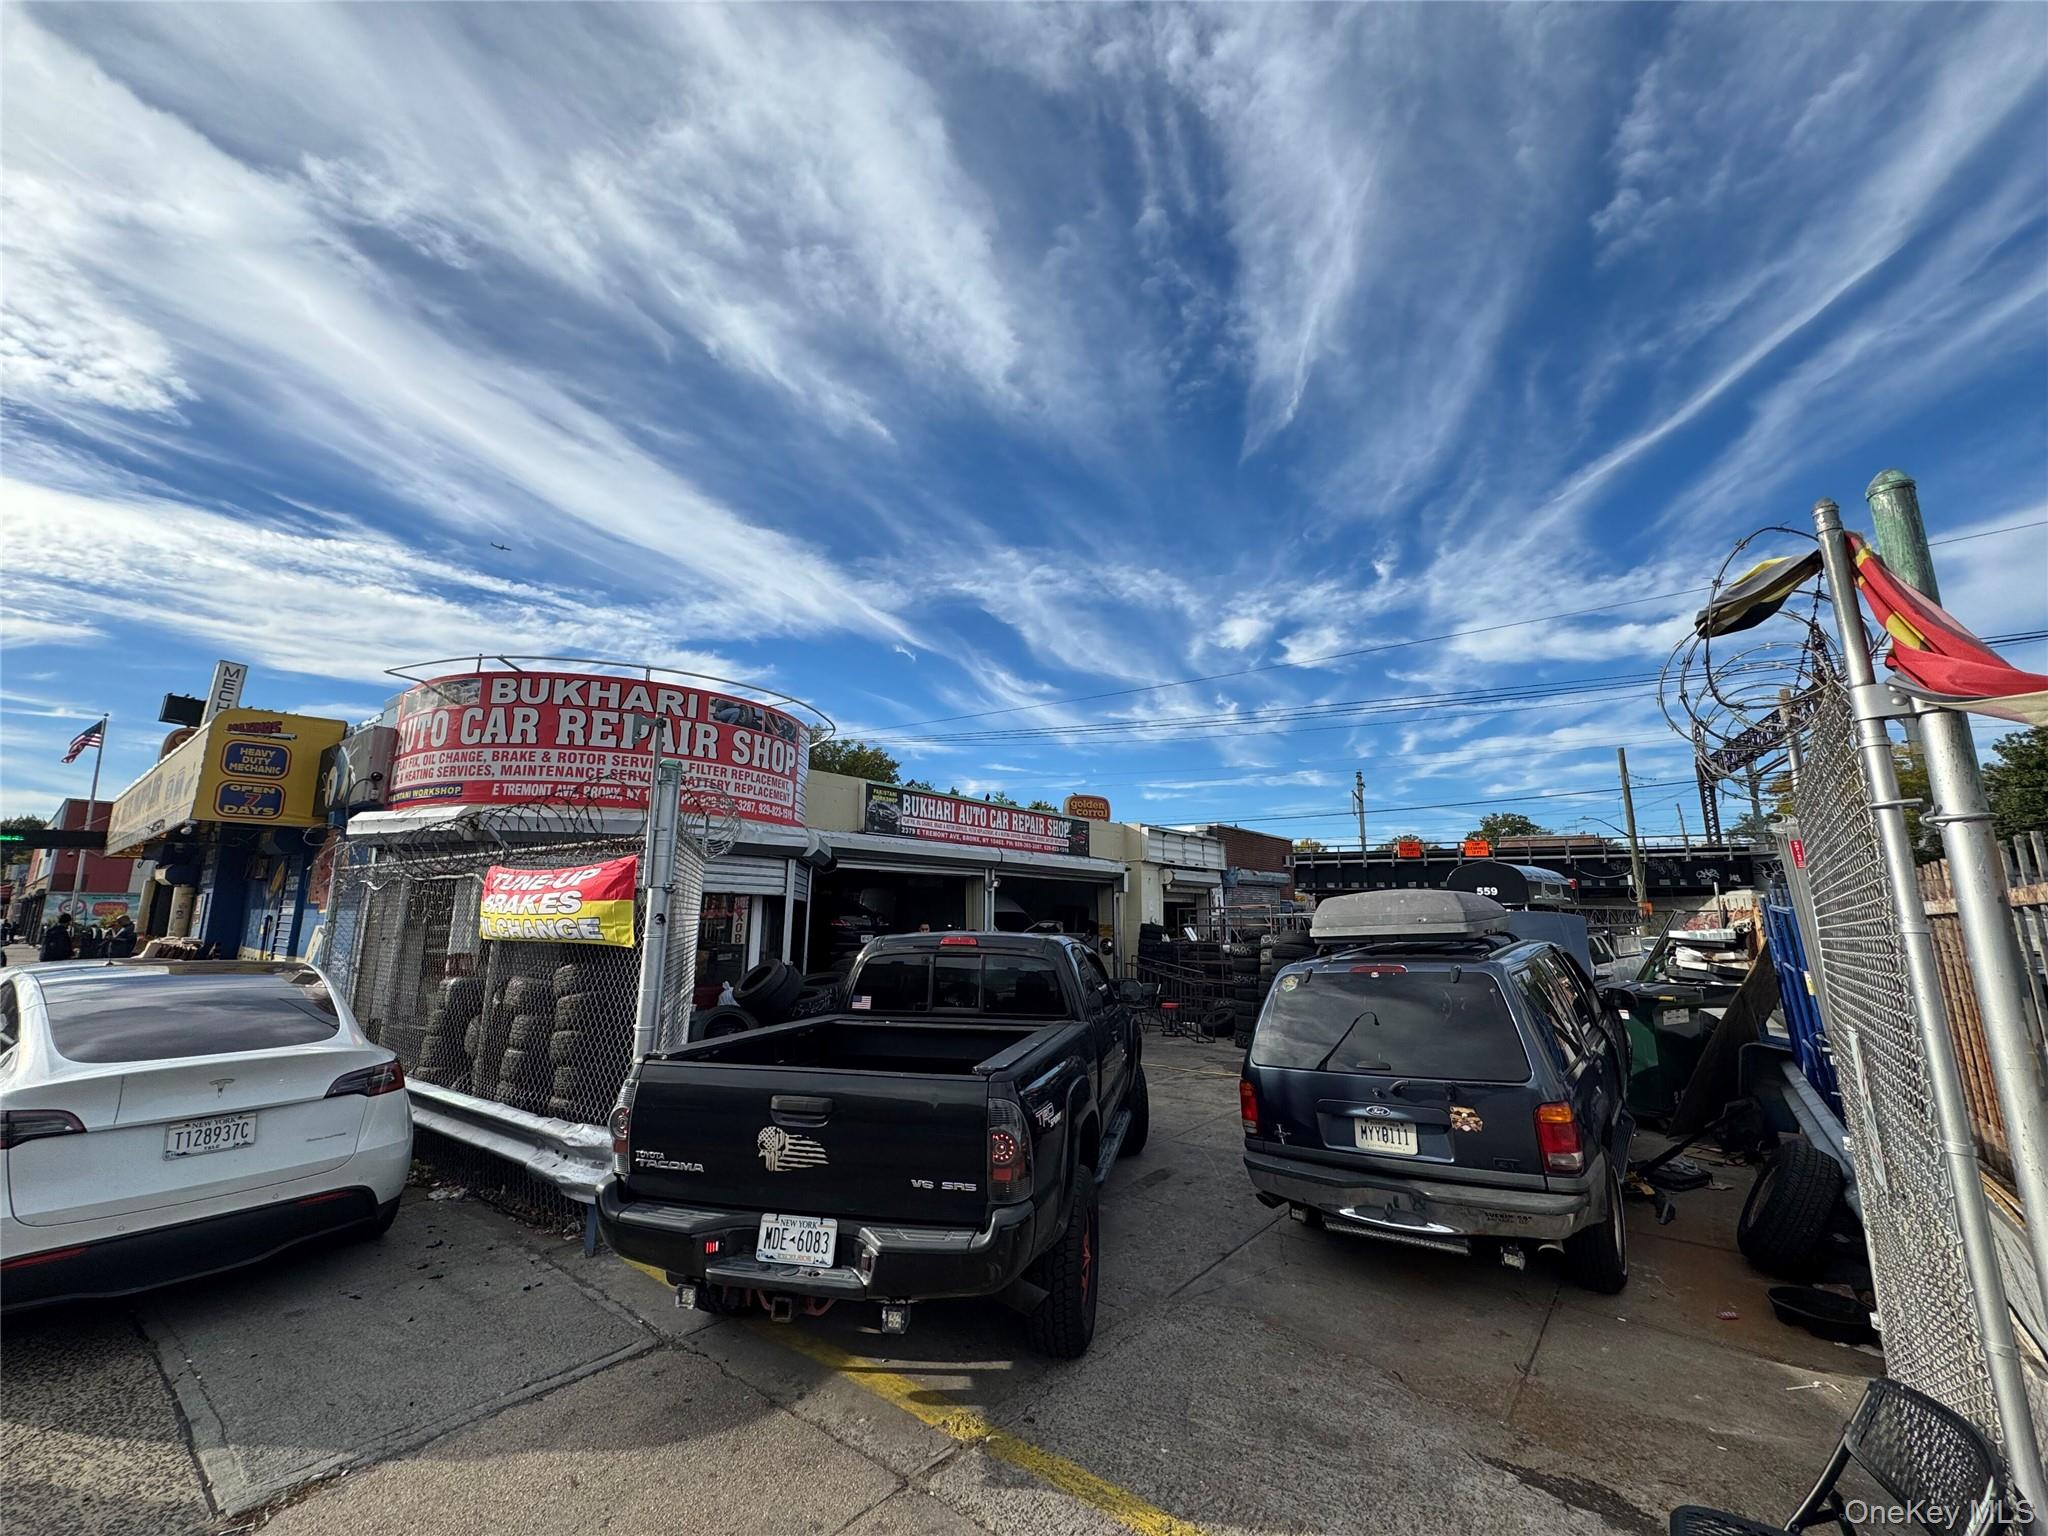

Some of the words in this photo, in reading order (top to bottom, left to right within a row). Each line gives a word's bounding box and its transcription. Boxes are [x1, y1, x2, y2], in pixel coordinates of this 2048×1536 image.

[491, 678, 698, 719] BUKHARI
[395, 710, 449, 756] AUTO
[460, 707, 540, 745] CAR
[556, 708, 719, 760] REPAIR
[732, 730, 796, 776] SHOP
[240, 747, 276, 758] HEAVY
[241, 756, 272, 765] DUTY
[423, 754, 436, 766] OIL
[439, 751, 487, 764] CHANGE,
[492, 751, 536, 763] BRAKE
[541, 751, 551, 763] &
[557, 752, 606, 766] ROTOR
[689, 763, 727, 778] FILTER
[229, 763, 282, 774] MECHANIC
[229, 785, 276, 794] OPEN
[437, 764, 495, 777] SERVICES,
[501, 765, 604, 780] MAINTENANCE
[734, 783, 790, 803] REPLACEMENT
[492, 783, 500, 796] E
[503, 783, 553, 797] TREMONT
[412, 786, 461, 797] WORKSHOP
[245, 794, 261, 807] 7
[1070, 800, 1105, 810] golden
[223, 805, 275, 816] DAYS
[902, 794, 955, 822] BUKHARI
[959, 804, 987, 827] AUTO
[990, 808, 1009, 829] CAR
[1012, 812, 1045, 835] REPAIR
[1047, 818, 1070, 839] SHOP
[1075, 807, 1108, 817] corral
[492, 867, 601, 891] TUNE-UP
[1476, 887, 1498, 896] 559
[482, 890, 582, 915] BRAKES
[498, 916, 605, 940] CHANGE
[192, 1120, 212, 1129] NEW
[213, 1117, 236, 1126] YORK
[176, 1122, 249, 1150] T128937C
[635, 1150, 665, 1160] TOYOTA
[635, 1158, 704, 1172] TACOMA
[910, 1179, 935, 1189] V6
[941, 1181, 977, 1192] SR5
[780, 1218, 797, 1228] NEW
[799, 1220, 818, 1230] YORK
